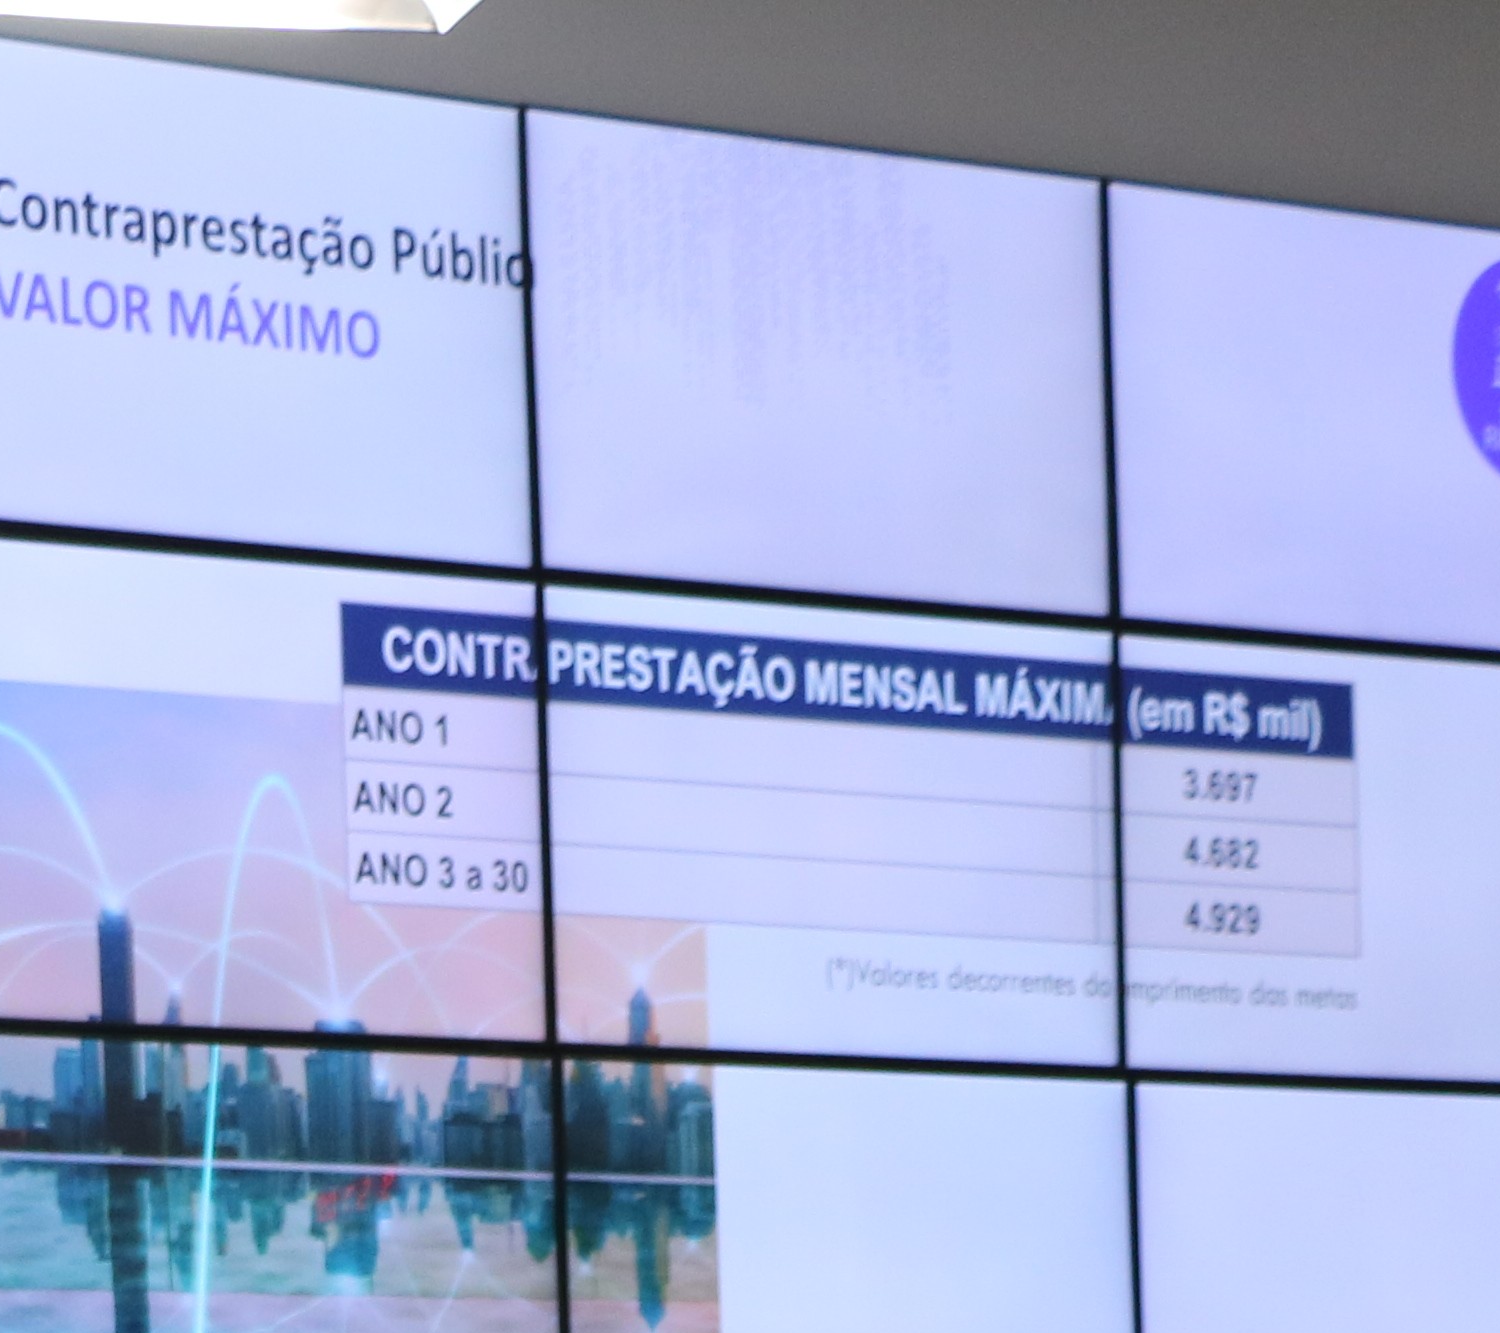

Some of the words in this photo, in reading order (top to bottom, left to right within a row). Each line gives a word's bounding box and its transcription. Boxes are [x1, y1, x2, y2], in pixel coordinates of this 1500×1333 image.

[393, 226, 533, 289] Públic
[169, 282, 381, 359] MÁXIMO
[381, 624, 796, 709] CONTRPRESTAÇÃO
[804, 658, 968, 716] MENSAL
[974, 665, 1114, 726] MÁXIM
[1127, 684, 1196, 741] (em
[1203, 688, 1252, 743] R$
[1257, 696, 1323, 754] mil)
[350, 708, 423, 746] ANO
[435, 713, 450, 746] 1
[353, 781, 425, 817] ANO
[435, 785, 455, 818] 2
[356, 852, 428, 889] ANO
[437, 856, 456, 889] 3
[466, 864, 483, 891] a
[492, 859, 529, 893] 30
[1184, 901, 1262, 937] 4.929
[1125, 977, 1240, 1006] mprimento
